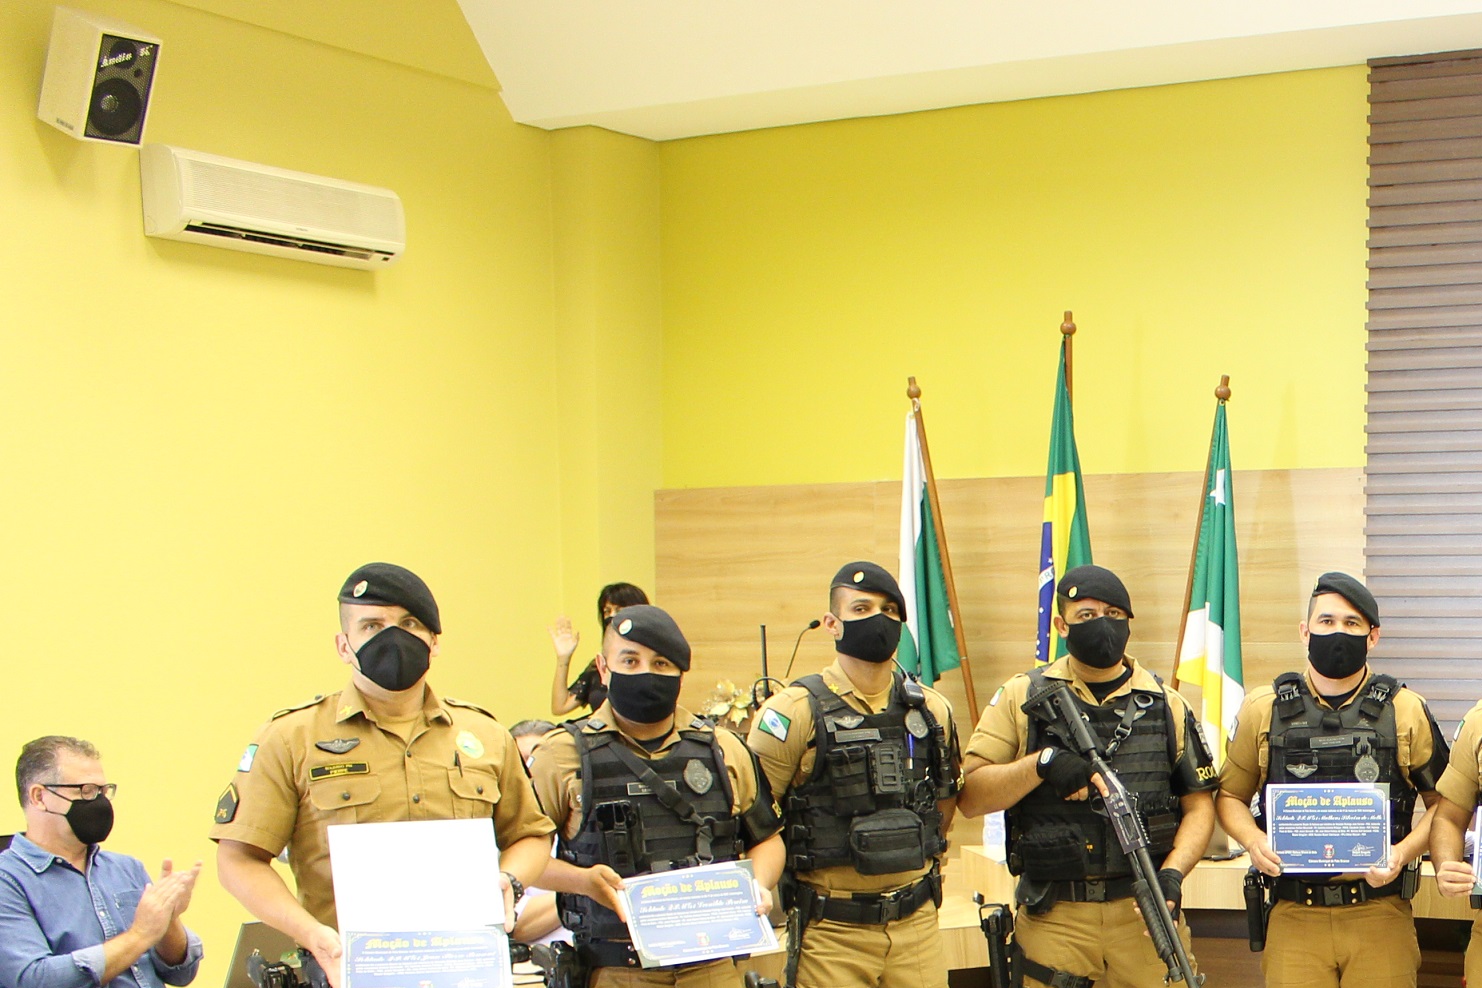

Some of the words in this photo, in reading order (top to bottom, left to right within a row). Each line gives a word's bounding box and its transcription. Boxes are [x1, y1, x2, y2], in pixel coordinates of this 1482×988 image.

[1284, 796, 1318, 808] Moção
[1320, 796, 1330, 806] de
[1332, 796, 1374, 807] Aplauso
[641, 883, 678, 898] Moção
[680, 882, 692, 892] de
[694, 879, 739, 892] Aplauso
